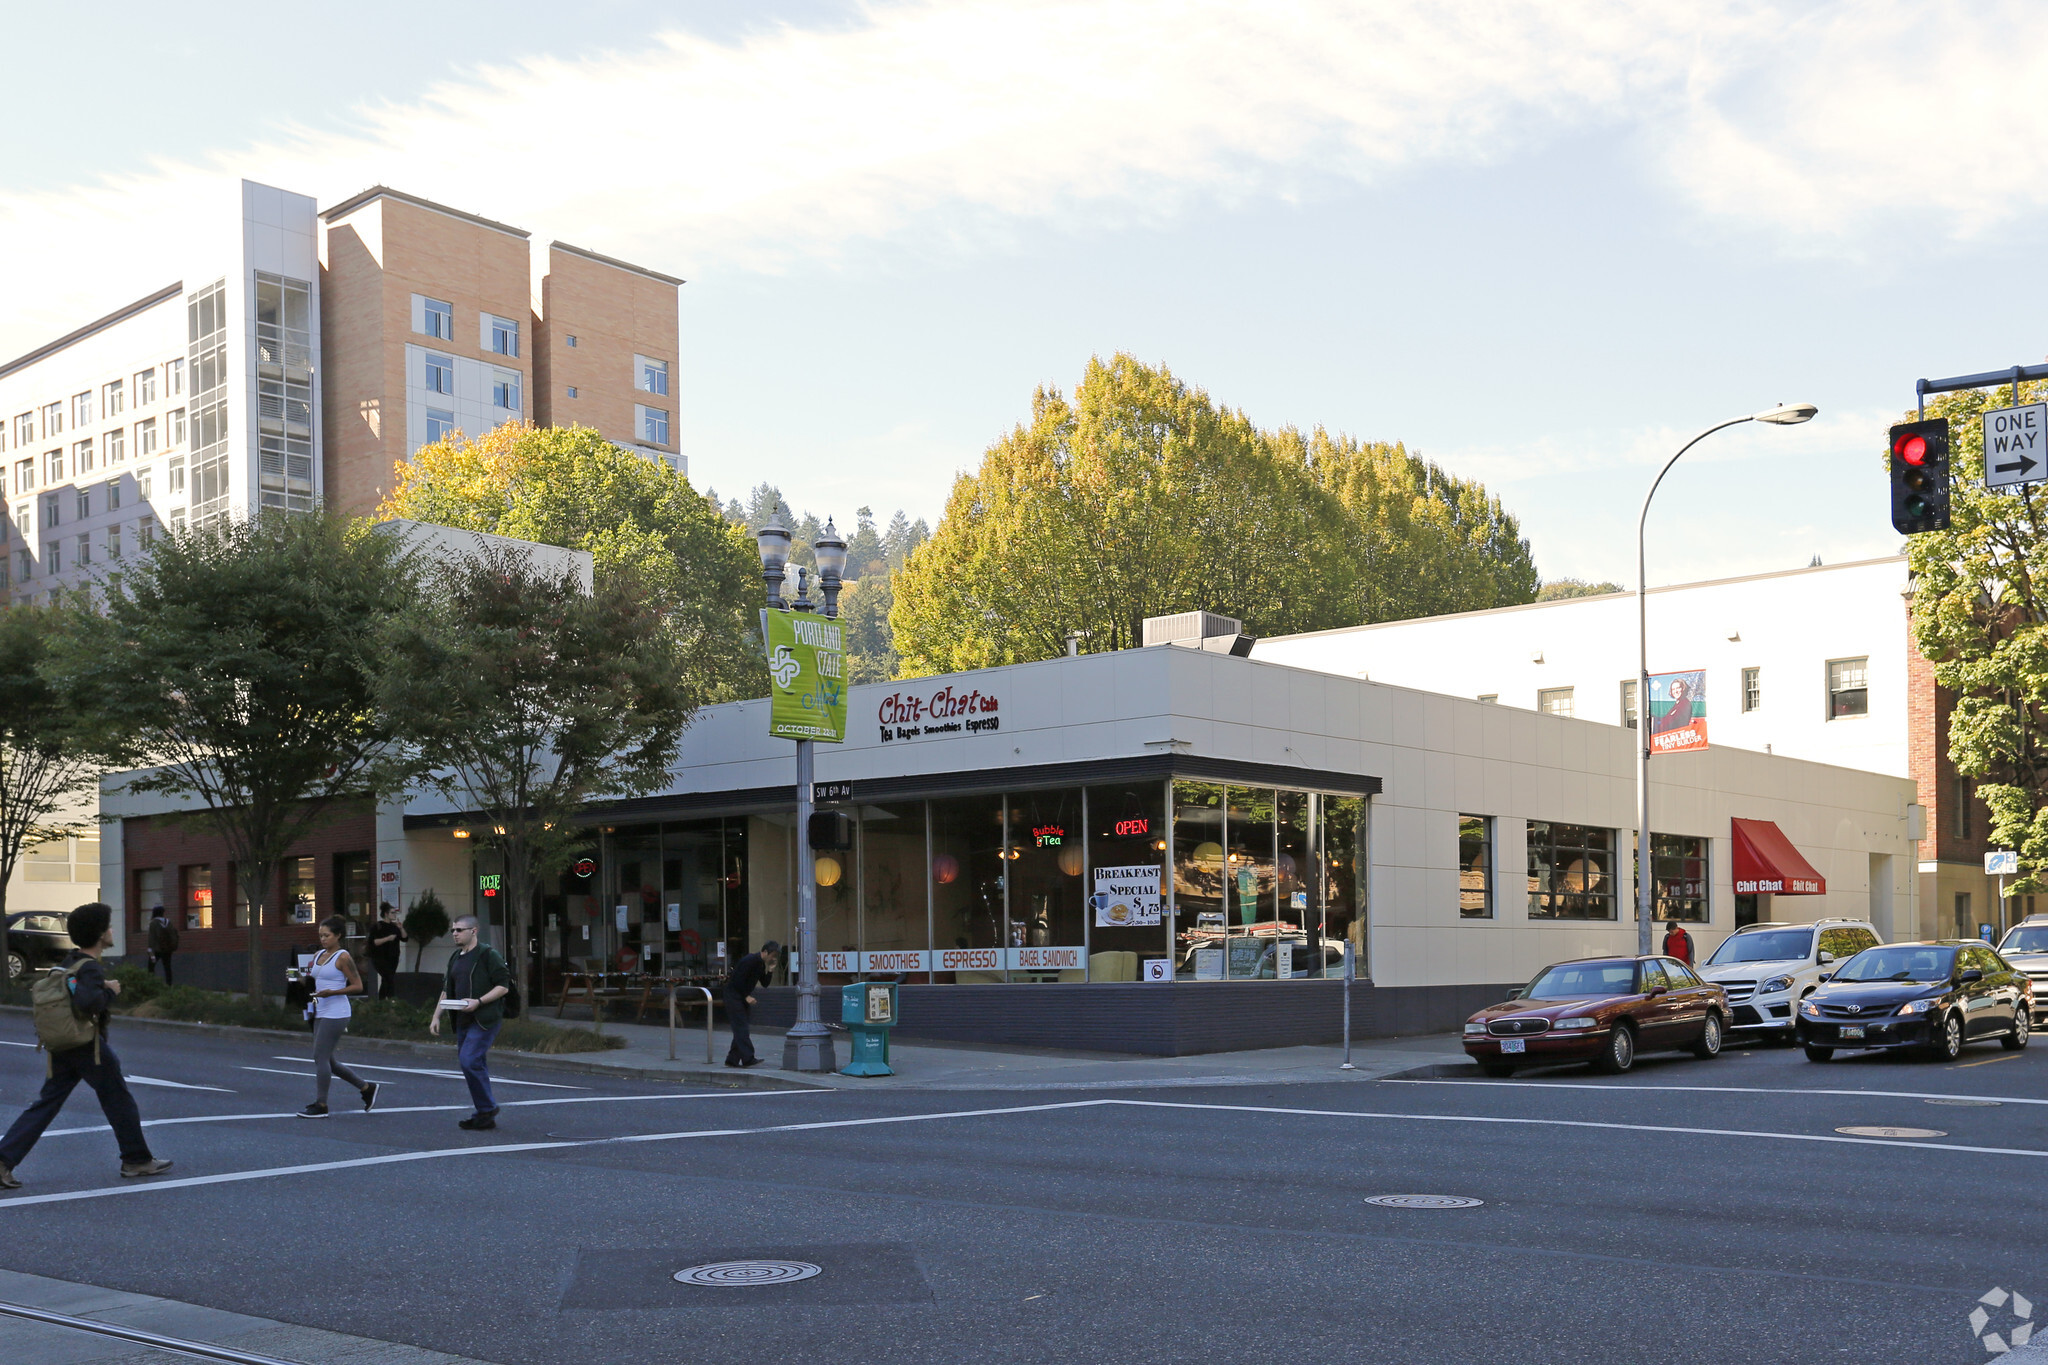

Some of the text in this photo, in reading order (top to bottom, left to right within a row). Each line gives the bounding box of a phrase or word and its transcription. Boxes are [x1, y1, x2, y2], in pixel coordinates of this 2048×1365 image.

[1995, 411, 2036, 433] ONE
[1994, 431, 2038, 454] WAY
[793, 619, 841, 651] PORTLAND
[817, 650, 842, 678] STATE
[878, 685, 980, 724] Chit-Chat
[777, 724, 821, 735] OCTOBER
[880, 716, 999, 743] Tea Bagels Smoothies Espresso
[1654, 729, 1697, 746] FEARLESS
[1677, 735, 1703, 747] BUILDER
[816, 785, 850, 798] SW 6th Av
[1032, 825, 1064, 837] Bubble
[1115, 819, 1149, 835] OPEN
[1043, 835, 1061, 846] Tea
[573, 863, 596, 873] OPEN
[1096, 868, 1160, 880] BREAKFAST
[480, 875, 501, 890] ROGUE
[1110, 884, 1157, 895] SPECIAL
[1736, 879, 1783, 893] Chit Chat
[1793, 879, 1818, 892] Chit Chat
[484, 889, 496, 897] ALES
[831, 953, 847, 970] TEA
[869, 953, 920, 970] SMOOTHIES
[943, 950, 997, 969] ESPRESSO
[1020, 950, 1077, 966] BAGEL SANDWICH
